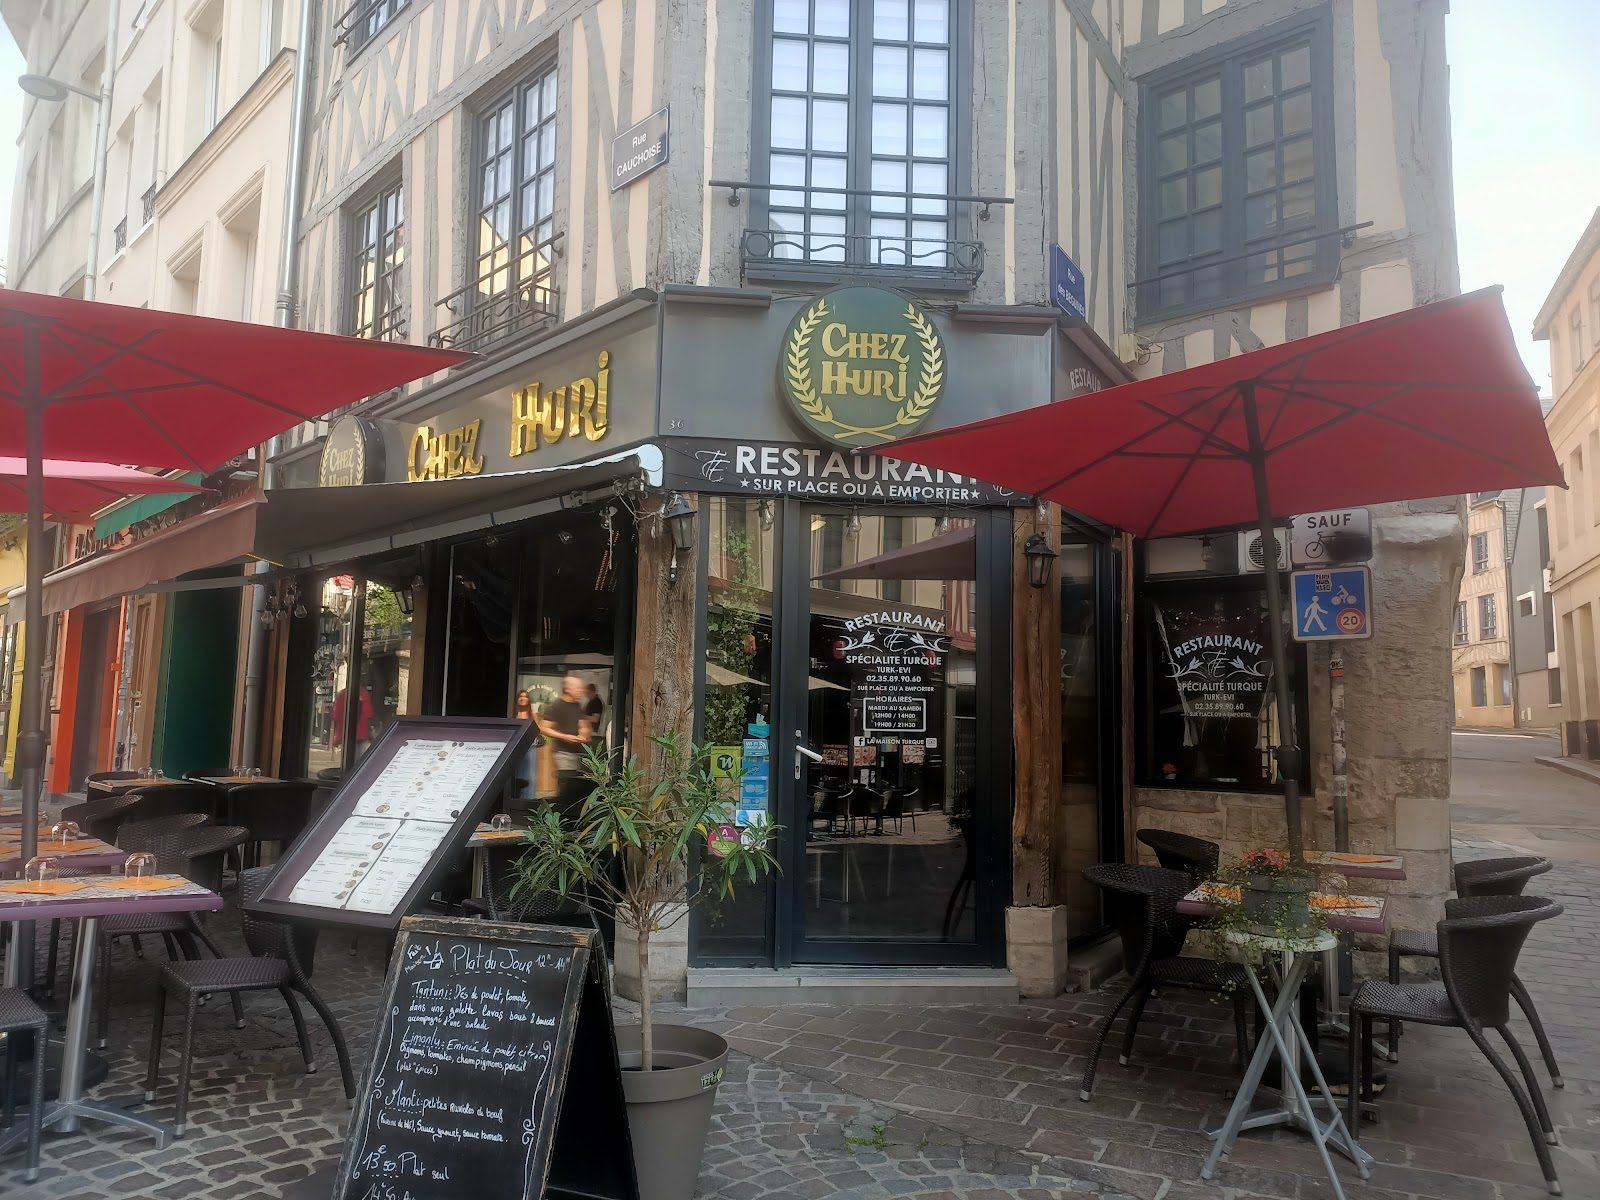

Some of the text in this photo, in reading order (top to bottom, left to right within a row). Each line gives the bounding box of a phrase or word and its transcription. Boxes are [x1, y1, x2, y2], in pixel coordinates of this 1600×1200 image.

[632, 133, 647, 148] Rue
[616, 141, 662, 177] CAUCHOISE
[1067, 267, 1076, 285] Rue
[735, 445, 977, 486] RESTAURA
[753, 477, 969, 501] SUR PLACE OU À EMPORTER
[1307, 513, 1352, 529] SAUF
[844, 611, 946, 633] RESTAURANT
[1343, 616, 1358, 626] 20
[1173, 634, 1264, 659] RESTAURANT
[902, 656, 942, 666] TURQUE
[876, 666, 912, 674] TURK-EVI
[866, 675, 922, 683] 02.35.89.90.60
[1226, 682, 1263, 691] TURQUE
[875, 695, 913, 703] HORAIRES
[1203, 693, 1235, 701] TURK-EVI
[899, 704, 922, 712] SAMEDI
[1194, 703, 1245, 711] 02.35.89.90.60
[450, 944, 485, 971] Plat
[484, 949, 497, 970] du
[409, 999, 426, 1013] dans
[431, 1005, 446, 1014] une
[448, 1001, 478, 1020] galette
[465, 1017, 490, 1030] salade
[431, 1166, 450, 1181] seul
